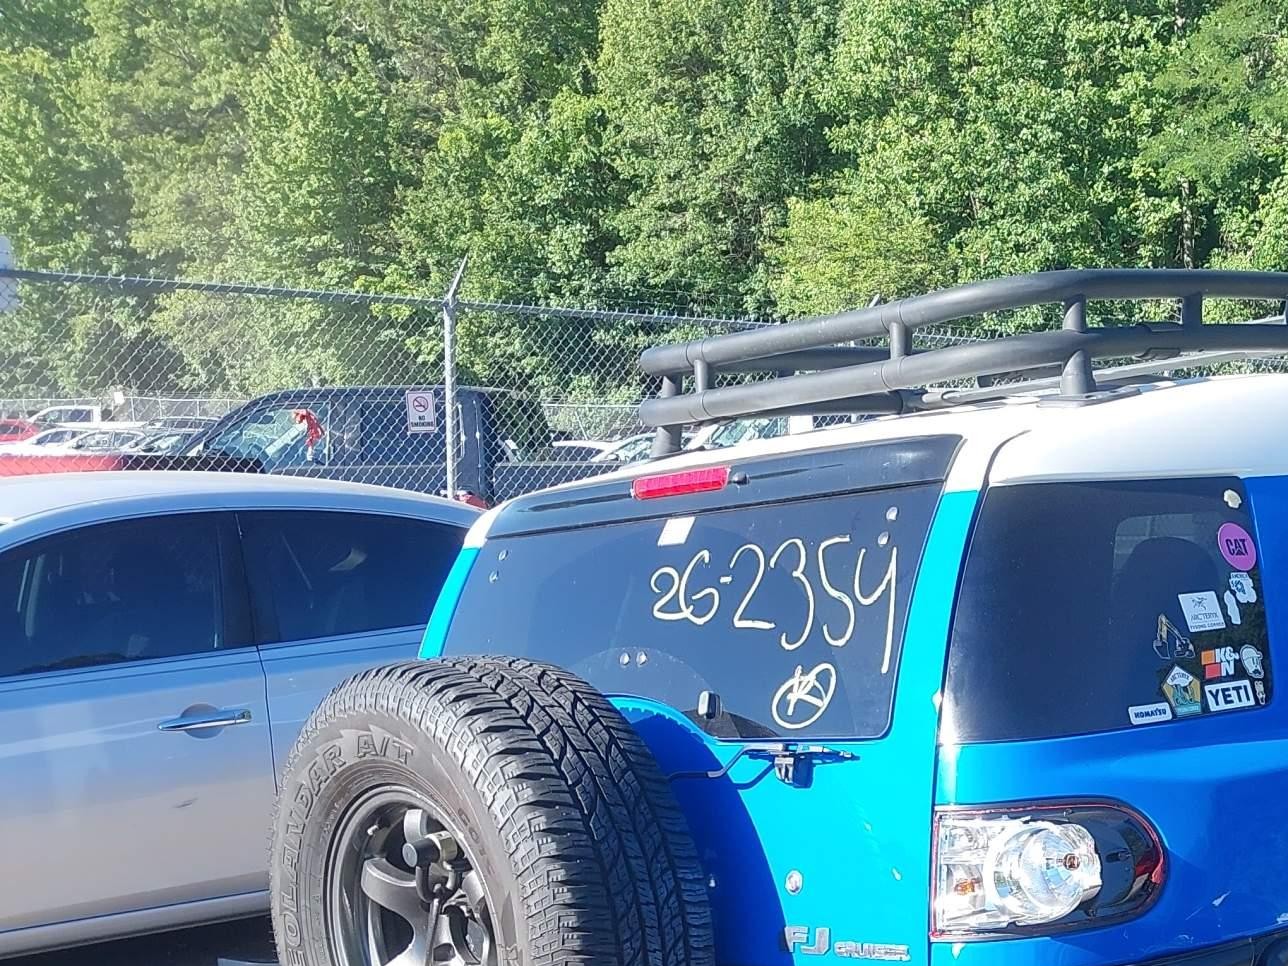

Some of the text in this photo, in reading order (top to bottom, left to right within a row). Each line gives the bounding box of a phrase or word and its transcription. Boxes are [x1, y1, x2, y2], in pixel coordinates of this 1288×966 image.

[1225, 538, 1249, 556] CAT
[1208, 685, 1251, 706] YETI
[1134, 708, 1167, 719] KOMATSU
[356, 733, 415, 765] A/T
[784, 926, 830, 955] FJ
